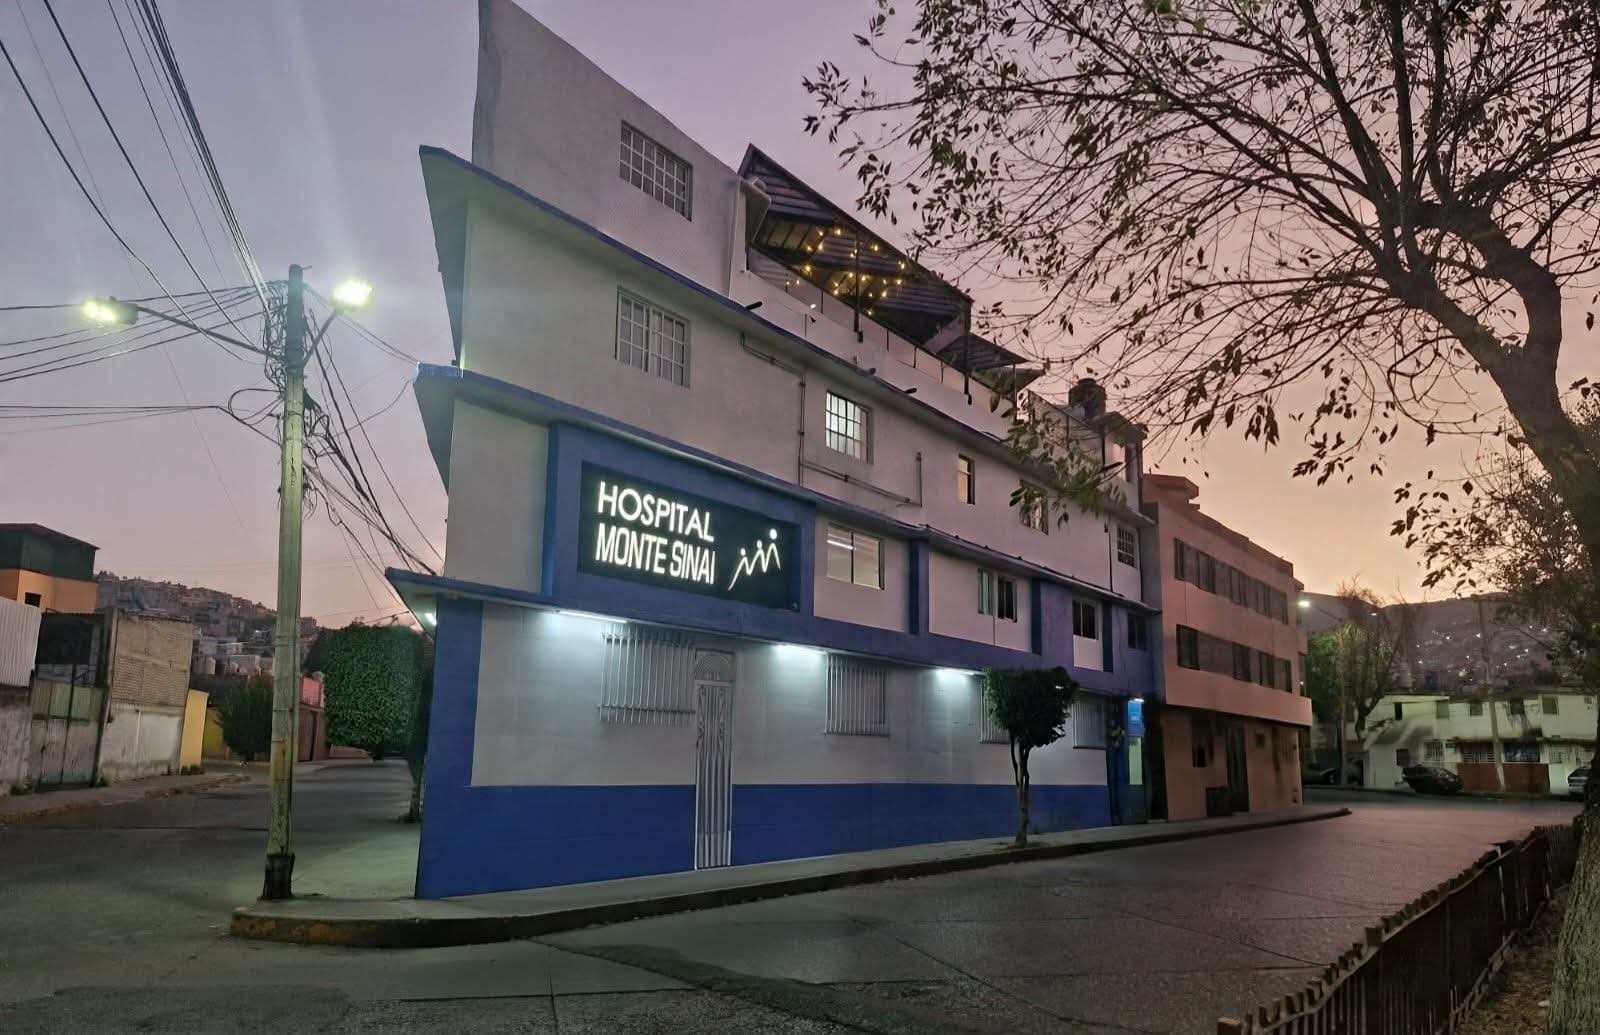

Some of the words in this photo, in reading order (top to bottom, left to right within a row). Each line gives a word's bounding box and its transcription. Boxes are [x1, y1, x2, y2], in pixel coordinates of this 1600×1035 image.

[598, 481, 714, 542] HOSPITAL
[595, 523, 668, 574] MONTE
[670, 540, 716, 584] SINAI
